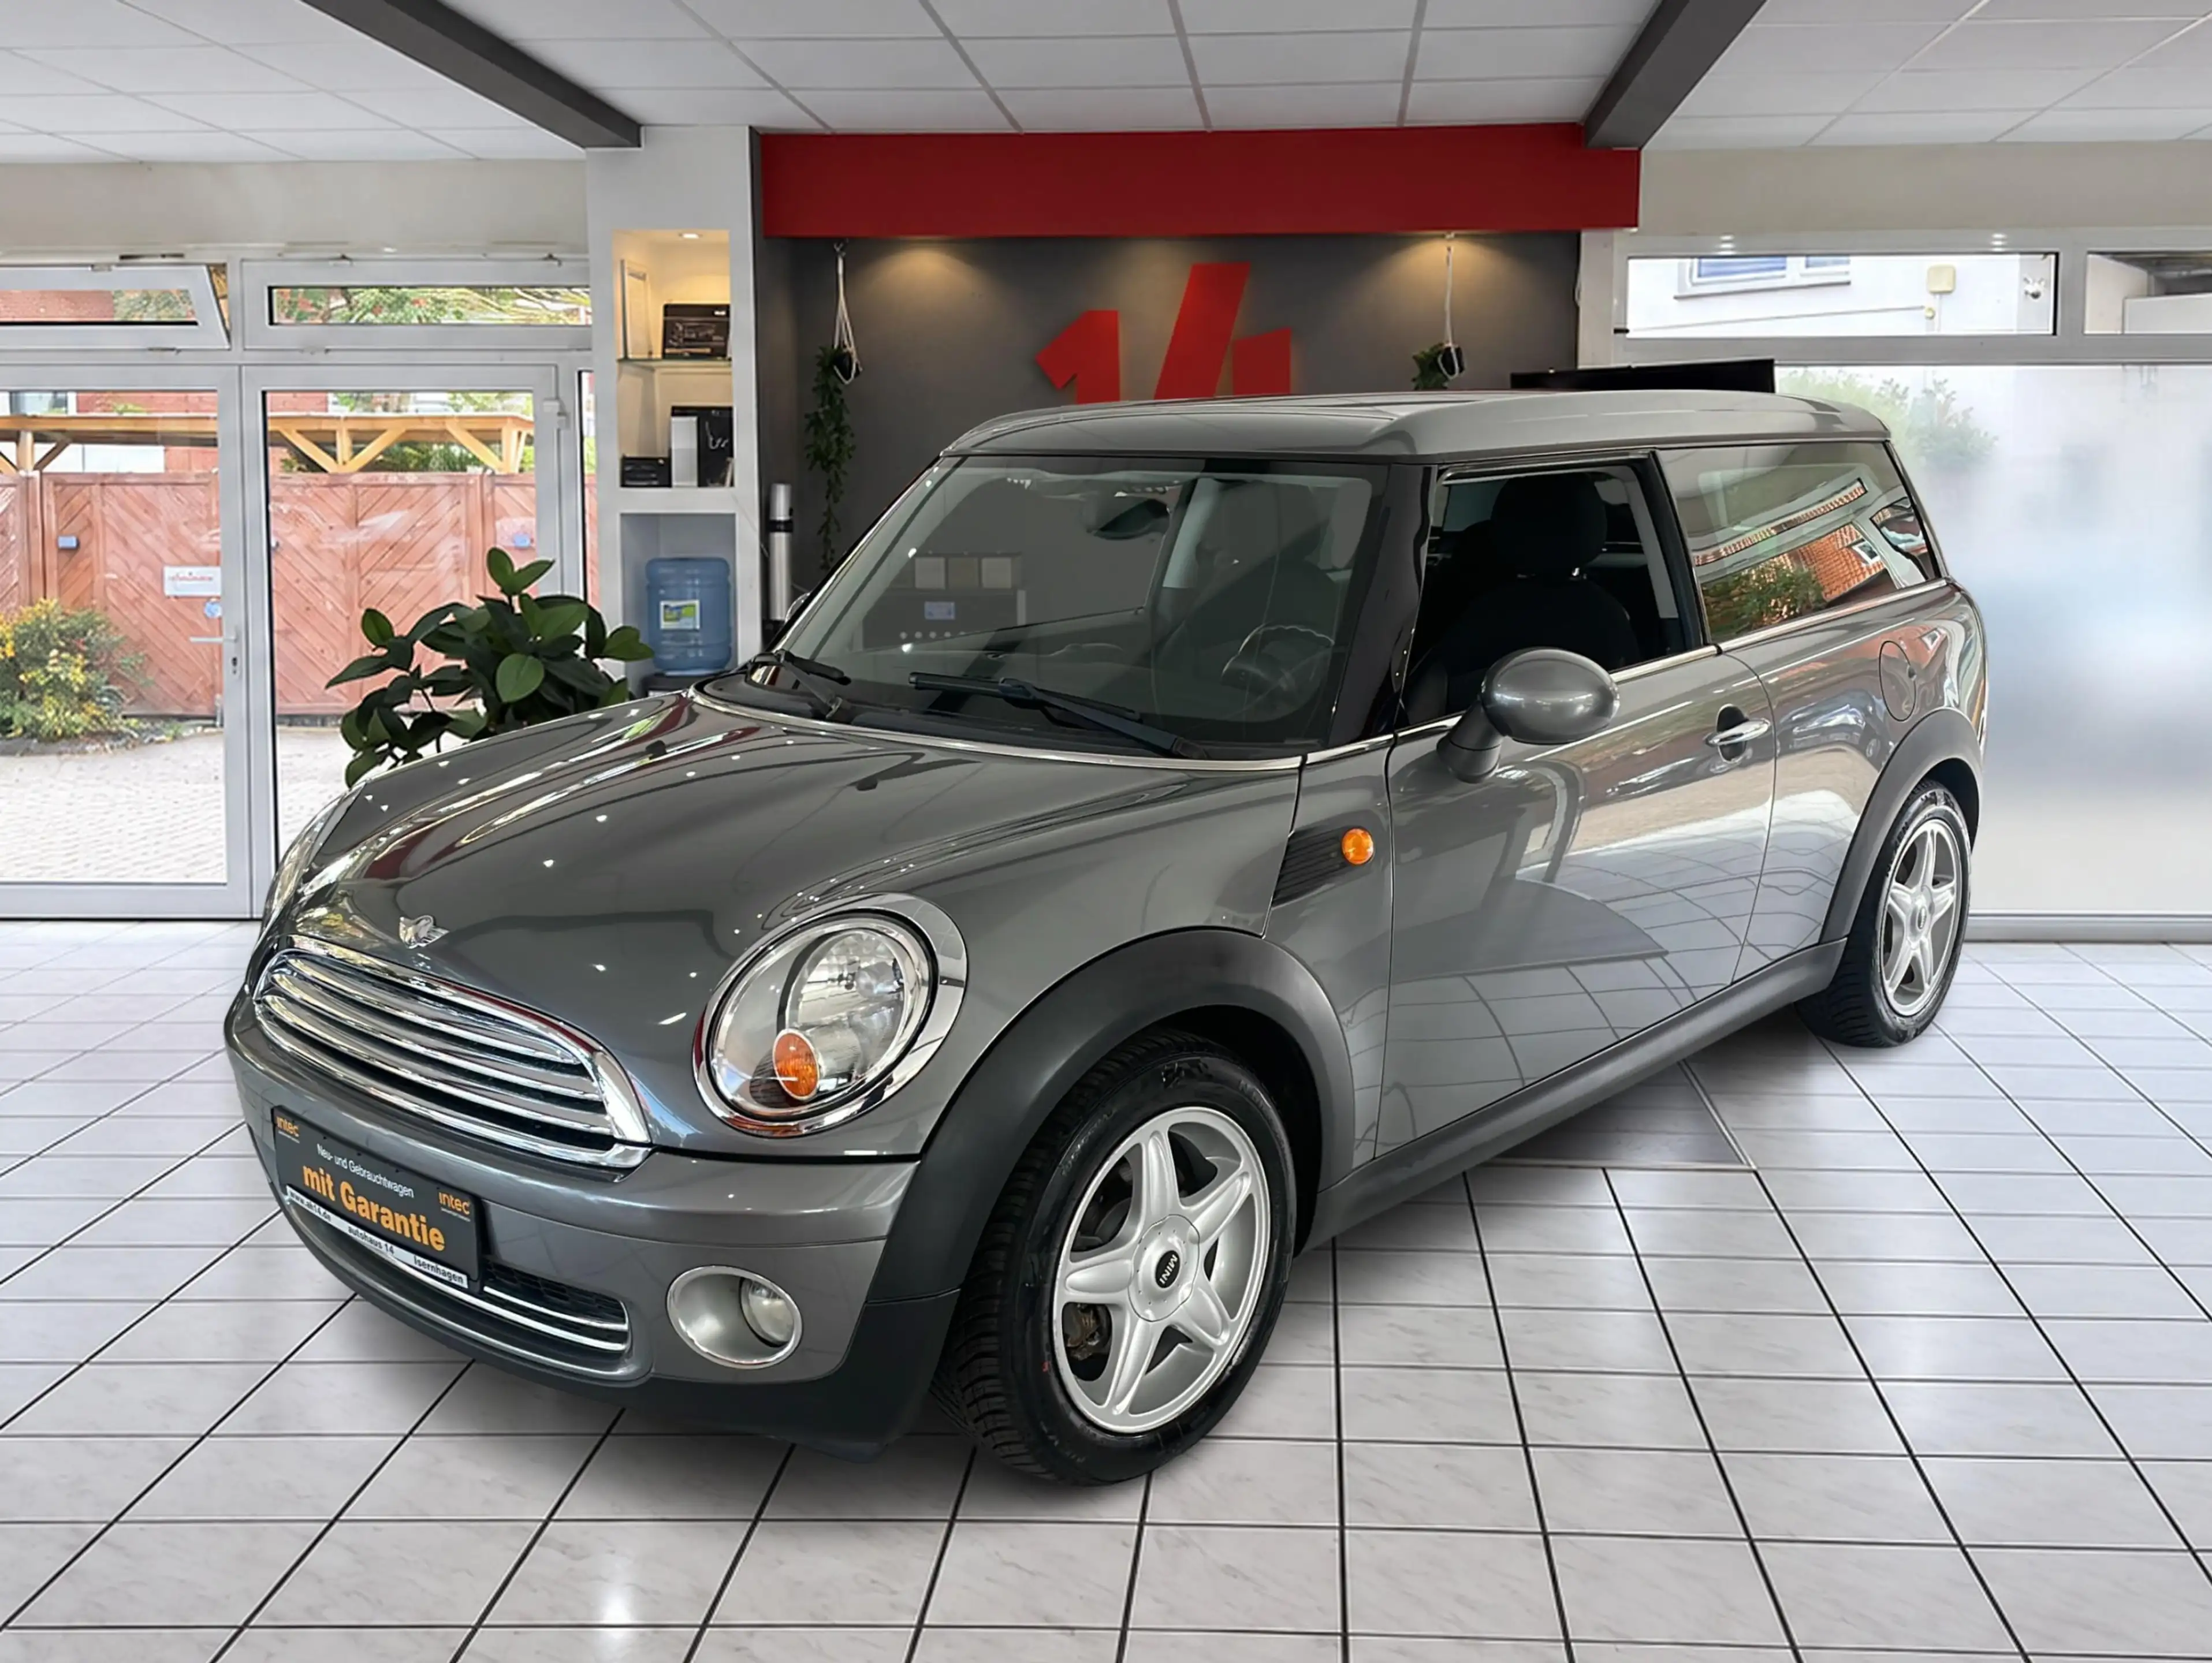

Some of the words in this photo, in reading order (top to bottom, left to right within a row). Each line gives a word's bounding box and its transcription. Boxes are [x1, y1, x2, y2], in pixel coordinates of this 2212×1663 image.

[276, 1116, 300, 1138] intec
[316, 1143, 334, 1161] Neu-
[334, 1155, 348, 1169] und
[348, 1159, 415, 1199] Gebrauchtwagen
[303, 1165, 336, 1202] mit
[340, 1181, 445, 1252] Garantie
[438, 1191, 470, 1215] intec
[348, 1225, 382, 1249] autohaus
[384, 1243, 394, 1255] 14
[414, 1255, 464, 1284] Isernhagen
[1159, 1254, 1178, 1285] MINI
